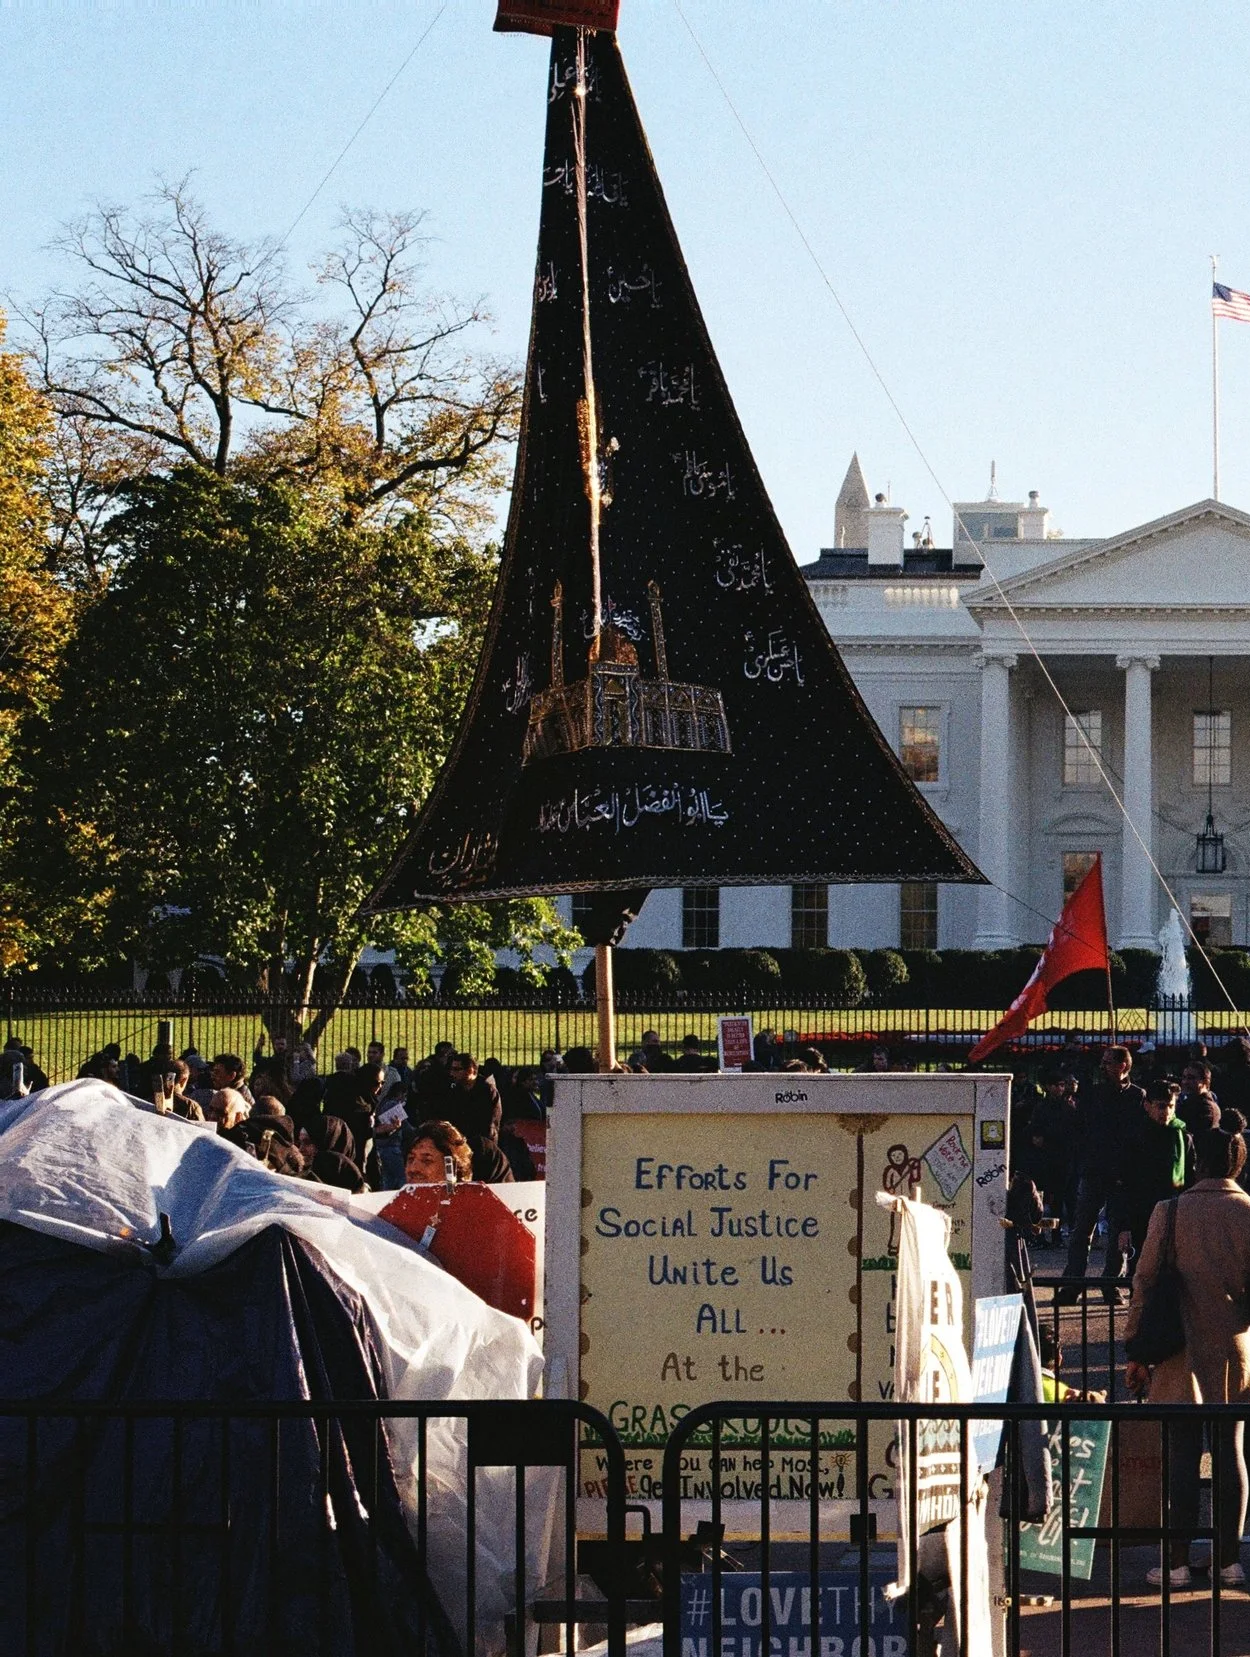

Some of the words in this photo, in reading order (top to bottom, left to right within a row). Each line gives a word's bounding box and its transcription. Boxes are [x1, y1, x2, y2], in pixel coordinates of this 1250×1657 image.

[634, 1157, 747, 1191] Efforts
[768, 1159, 818, 1191] For
[595, 1207, 698, 1238] Social
[710, 1206, 819, 1238] Justice
[648, 1254, 739, 1286] Unite
[760, 1255, 794, 1287] Us
[660, 1352, 698, 1383] At
[718, 1355, 765, 1383] the
[595, 1456, 653, 1472] Were
[743, 1454, 774, 1473] hep
